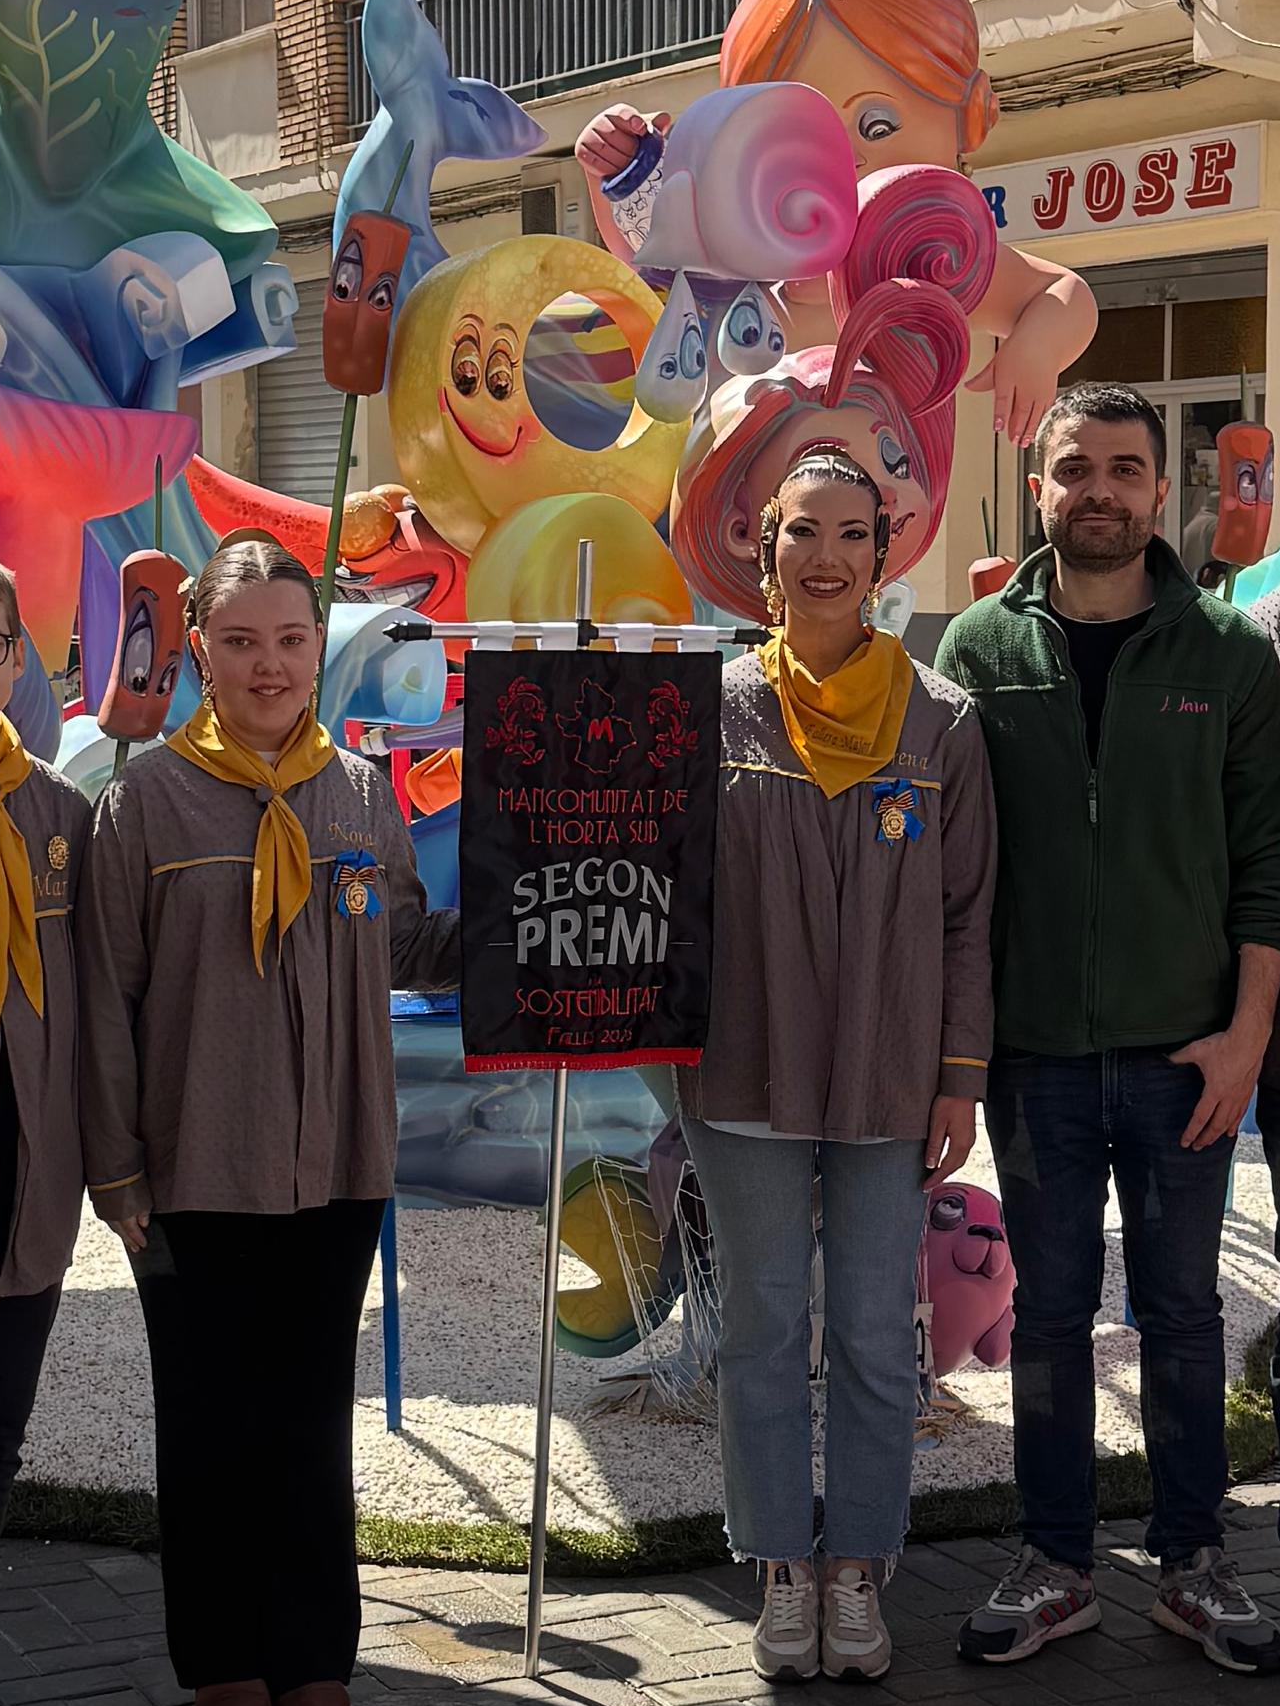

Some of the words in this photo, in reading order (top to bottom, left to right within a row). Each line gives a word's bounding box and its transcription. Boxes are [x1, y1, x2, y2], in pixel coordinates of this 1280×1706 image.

[1031, 138, 1237, 230] JOSE
[498, 787, 655, 814] MANCOMUNITAT
[662, 789, 689, 814] DE
[530, 819, 620, 845] L'HORTA
[628, 819, 660, 844] SUD
[512, 856, 674, 916] SEGON
[516, 904, 669, 967] PREMI
